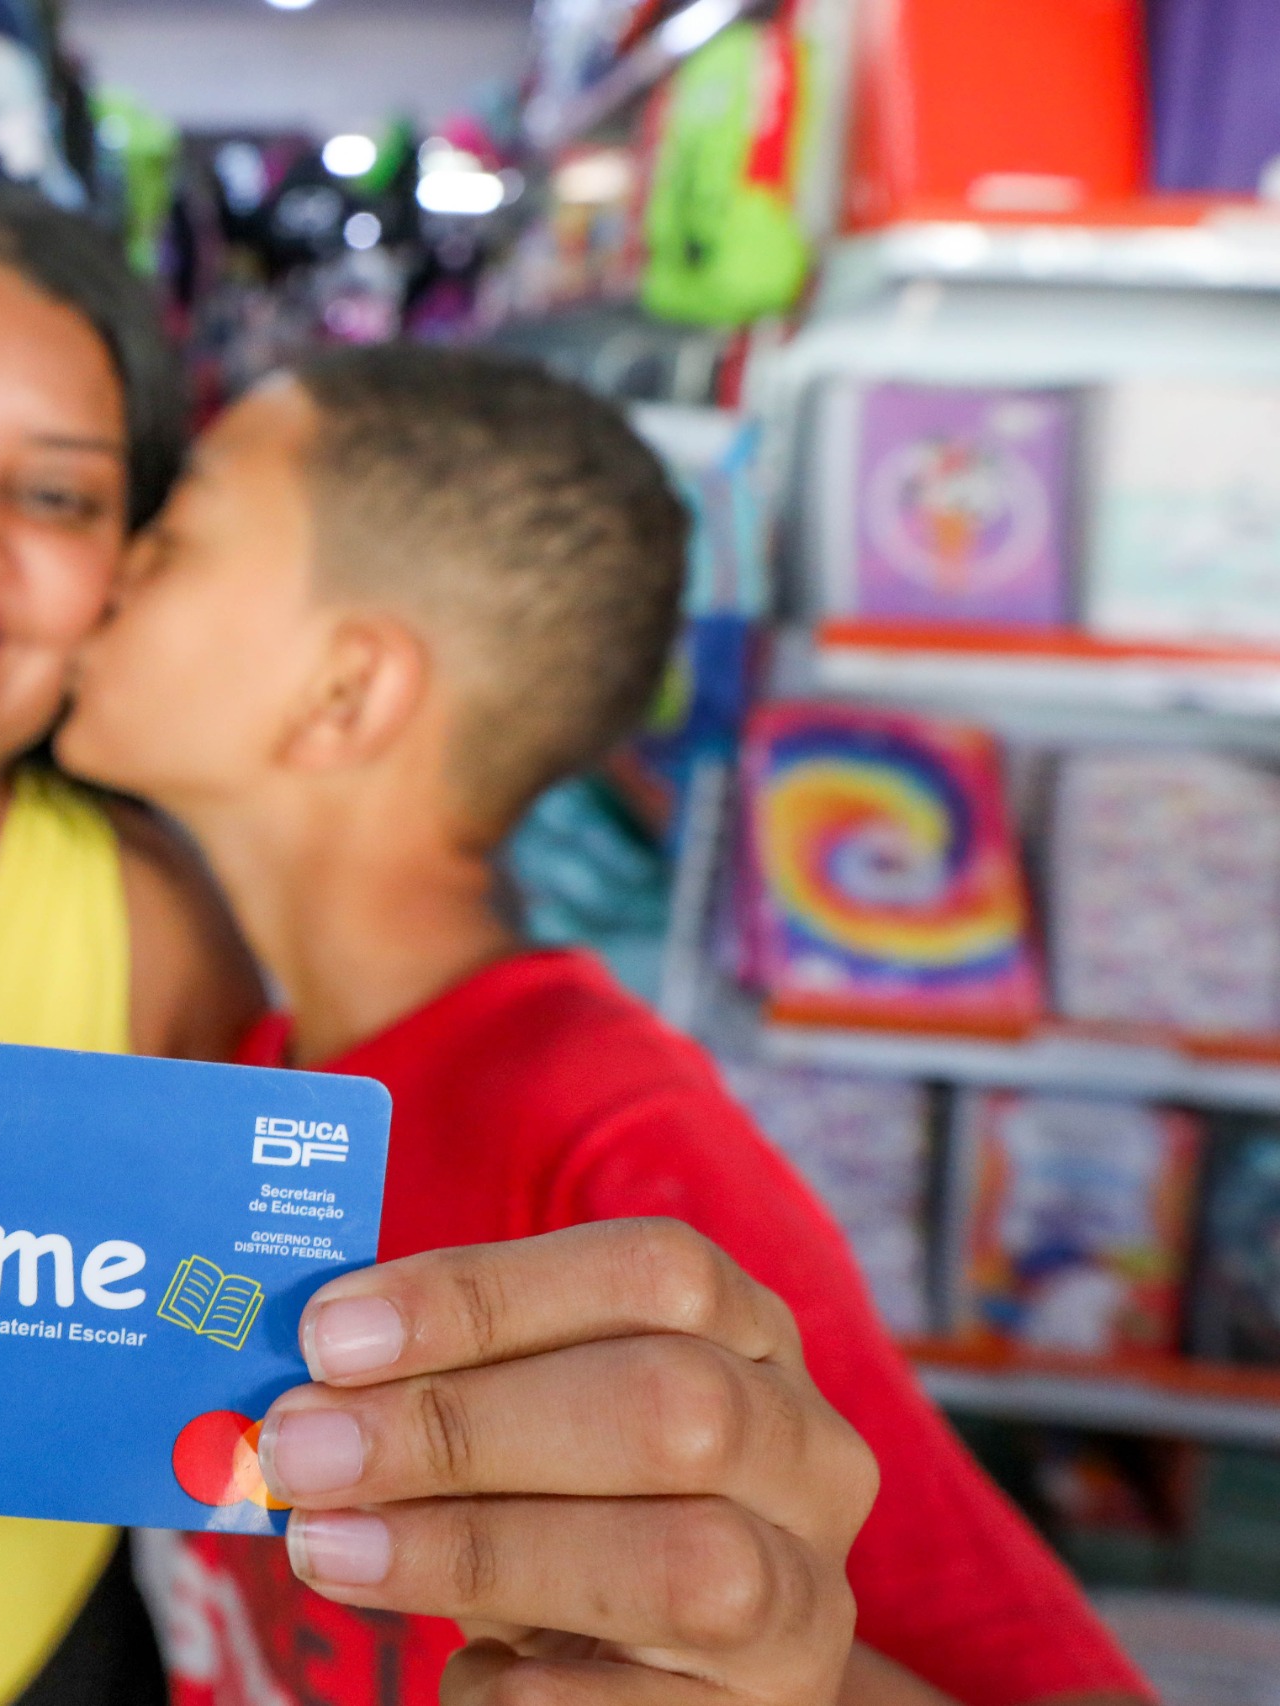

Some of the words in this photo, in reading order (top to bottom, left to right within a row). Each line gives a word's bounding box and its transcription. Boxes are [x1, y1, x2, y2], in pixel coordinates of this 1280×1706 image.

[254, 1116, 350, 1142] EDUCA
[252, 1136, 350, 1167] DF
[260, 1184, 336, 1203] Secretaria
[249, 1199, 267, 1212] de
[271, 1201, 344, 1220] Educação
[251, 1231, 310, 1246] GOVERNO
[313, 1236, 331, 1248] DO
[234, 1241, 289, 1256] DISTRITO
[292, 1247, 346, 1261] FEDERAL
[68, 1323, 147, 1346] Escolar
